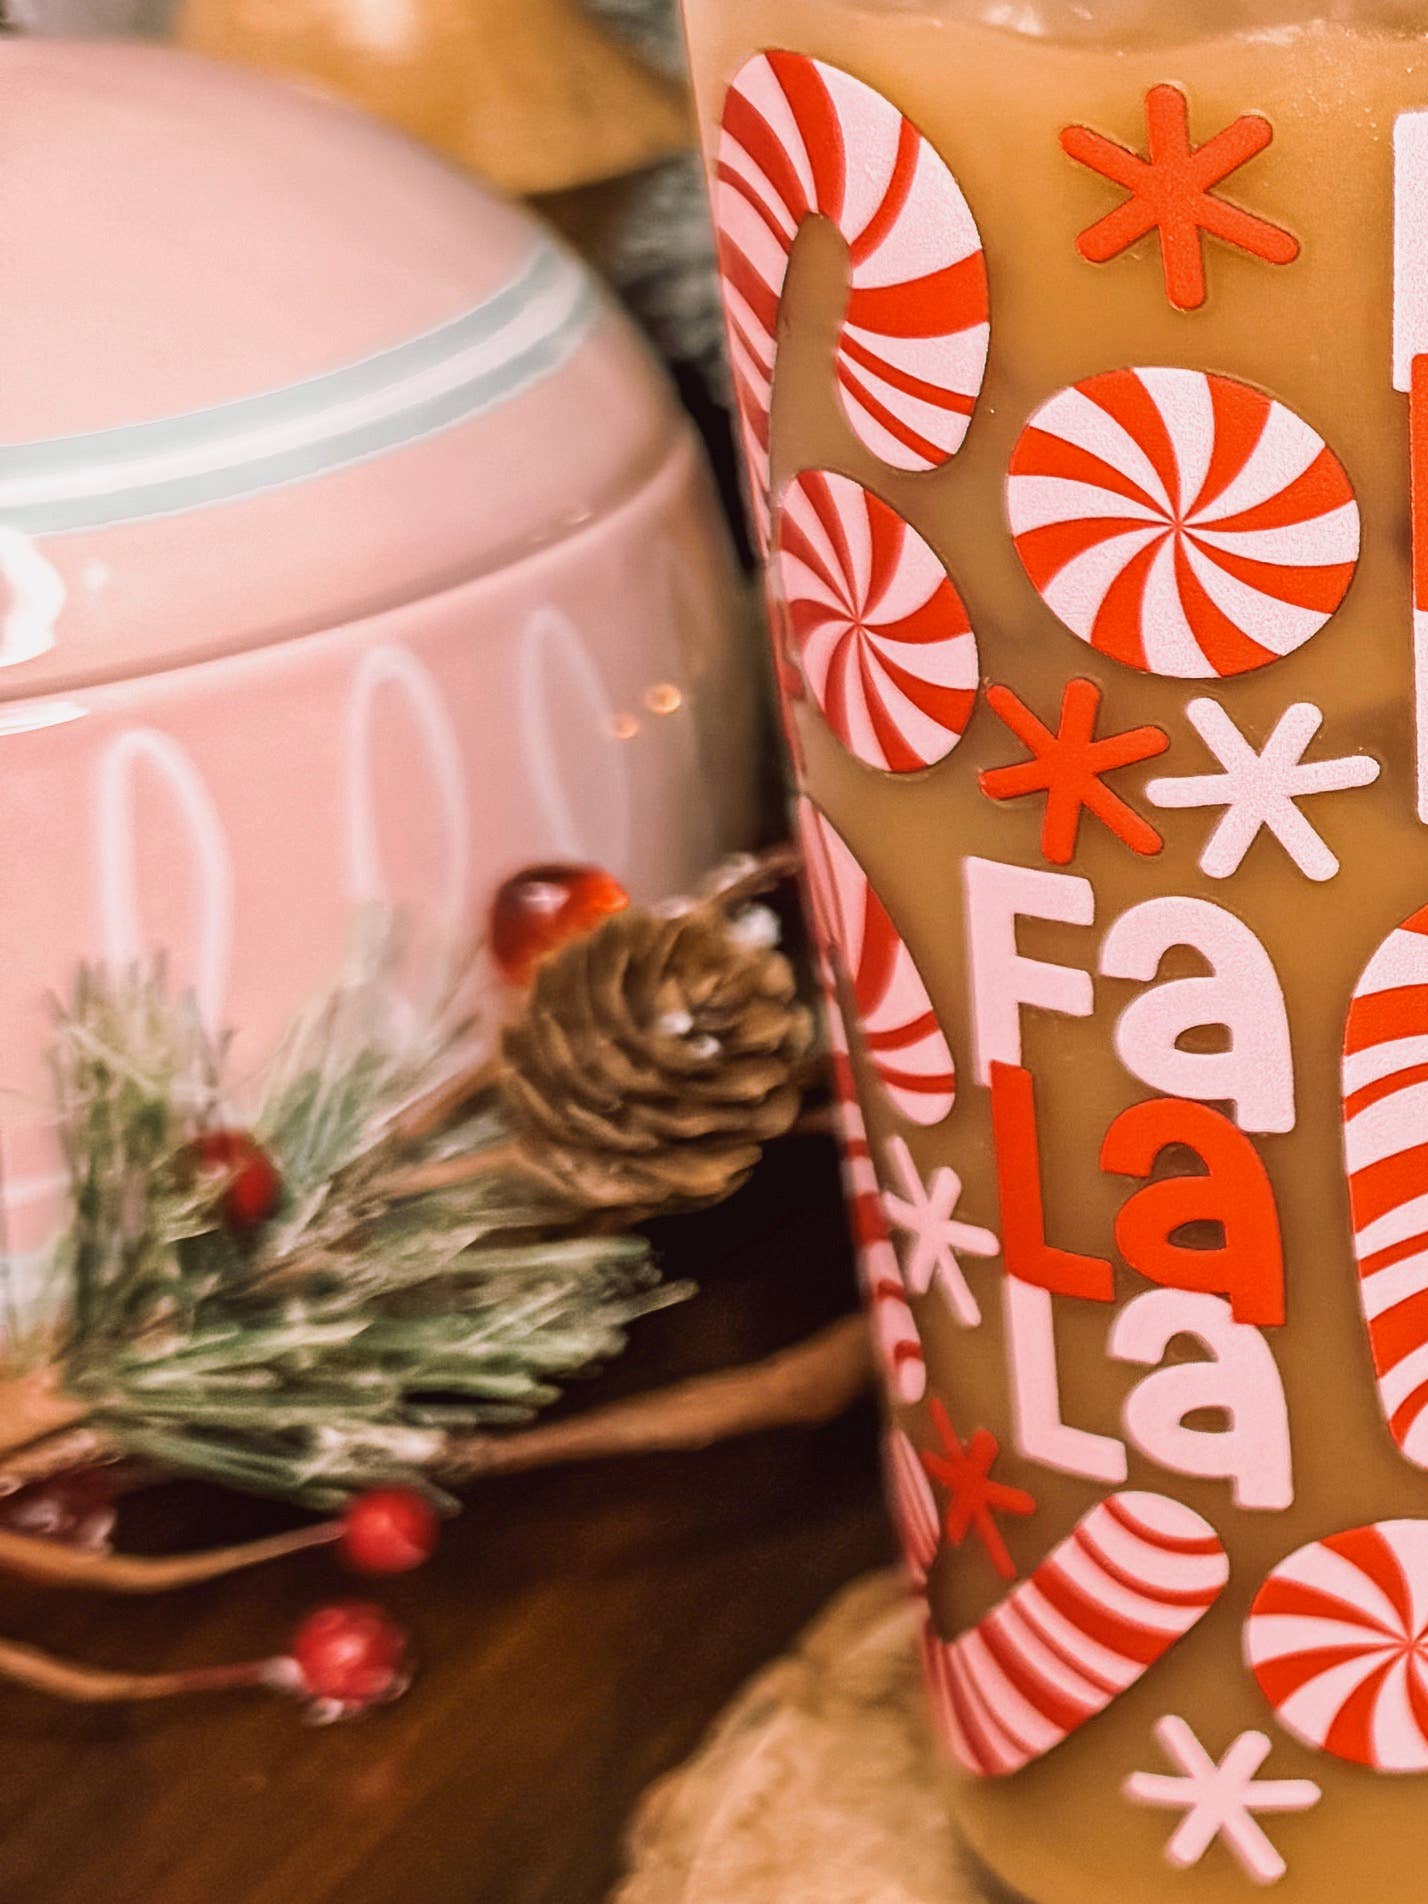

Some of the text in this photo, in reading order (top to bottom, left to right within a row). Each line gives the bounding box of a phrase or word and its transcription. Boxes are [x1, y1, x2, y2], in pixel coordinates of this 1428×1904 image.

[960, 854, 1295, 1134] Fa
[989, 1061, 1288, 1328] La
[1006, 1276, 1293, 1511] La
